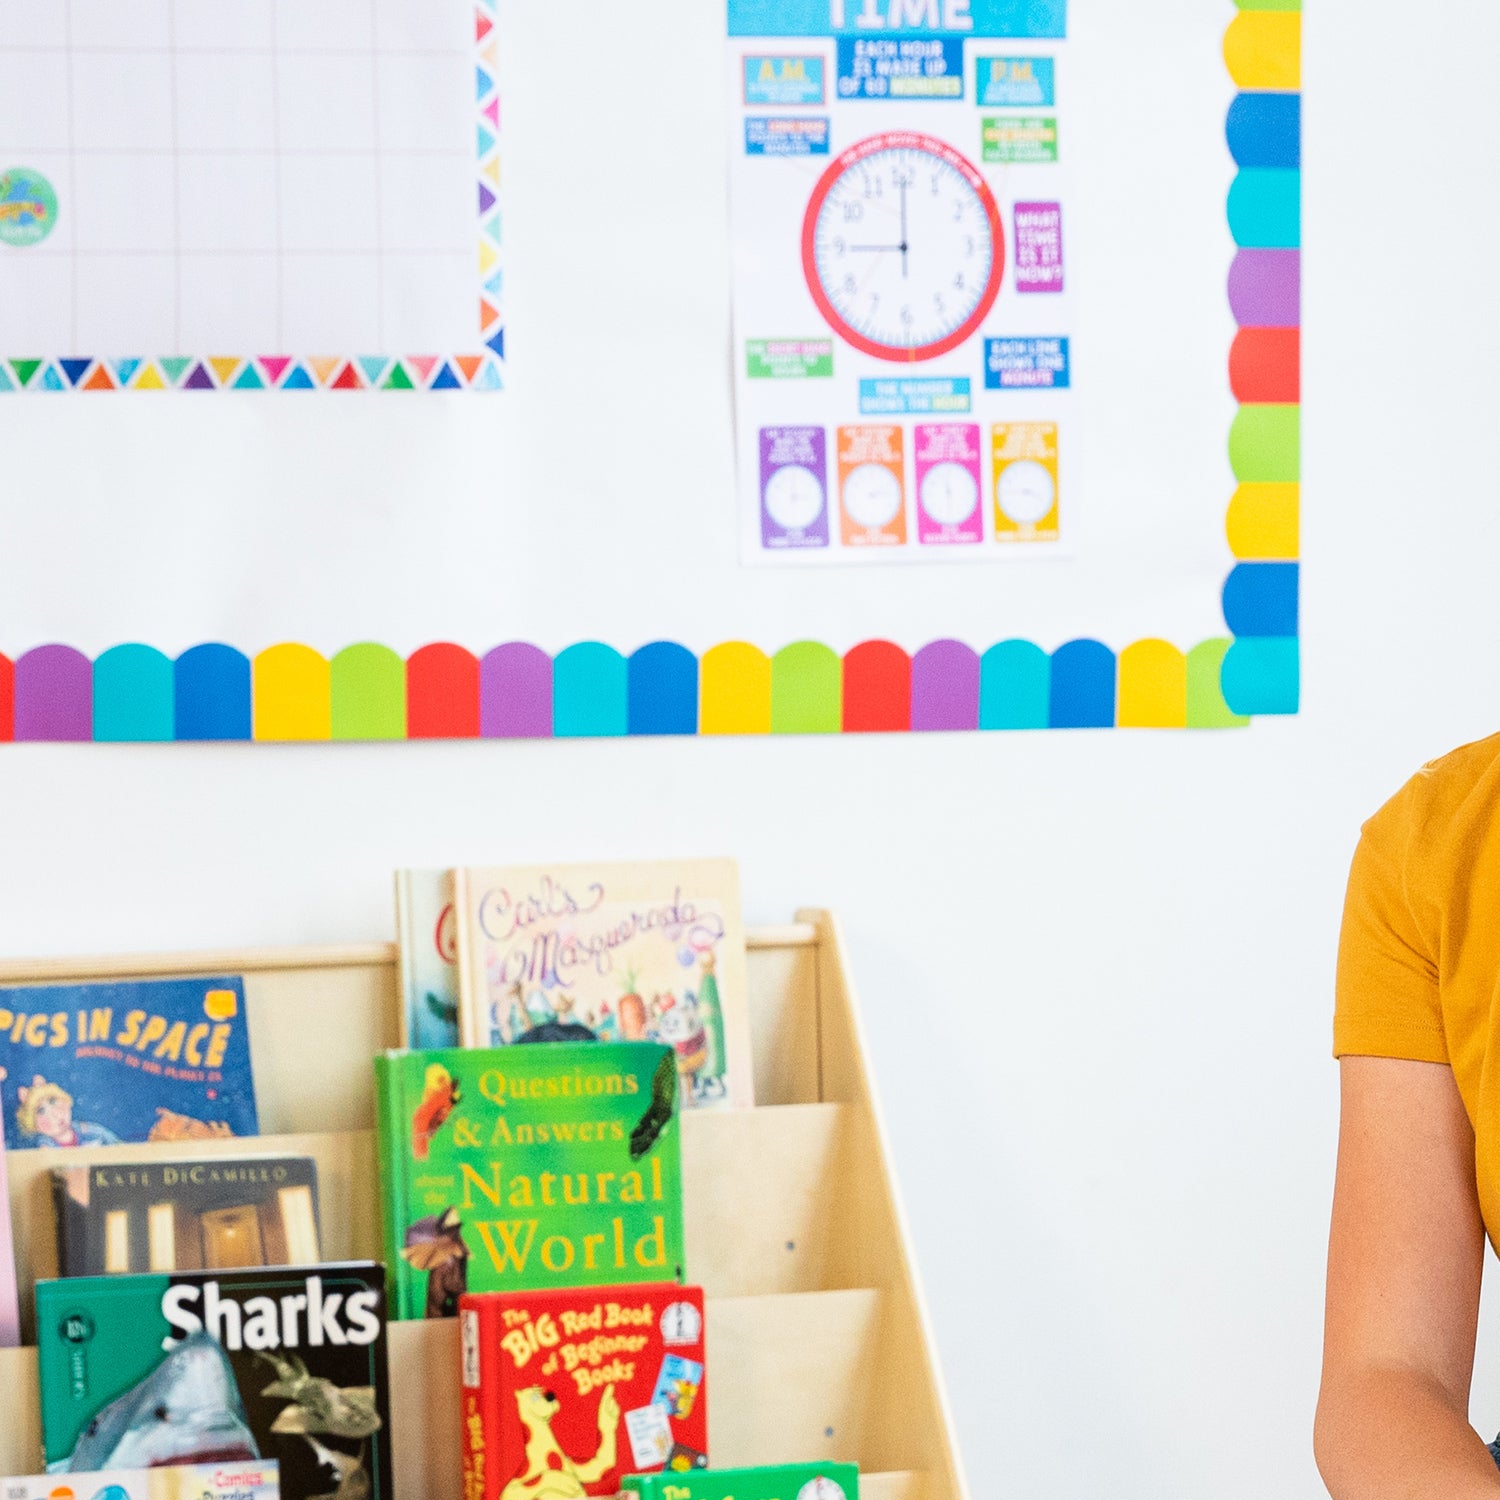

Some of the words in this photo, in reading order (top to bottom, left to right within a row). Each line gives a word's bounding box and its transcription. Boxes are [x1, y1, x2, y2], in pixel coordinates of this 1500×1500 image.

[843, 202, 865, 224] 10
[480, 874, 603, 942] Carl's
[0, 1009, 69, 1048] PIGS
[77, 1007, 113, 1043] IN
[117, 1009, 232, 1067] SPACE
[479, 1067, 639, 1106] Questions
[453, 1116, 482, 1147] &
[490, 1116, 624, 1146] Answers
[459, 1156, 664, 1209] Natural
[474, 1215, 668, 1274] World
[161, 1275, 381, 1351] Sharks
[501, 1312, 561, 1368] BIG
[559, 1303, 602, 1336] Red
[604, 1302, 654, 1328] Book
[502, 1308, 531, 1328] The
[541, 1352, 559, 1376] of
[560, 1334, 649, 1371] Beginner
[571, 1357, 637, 1397] Books
